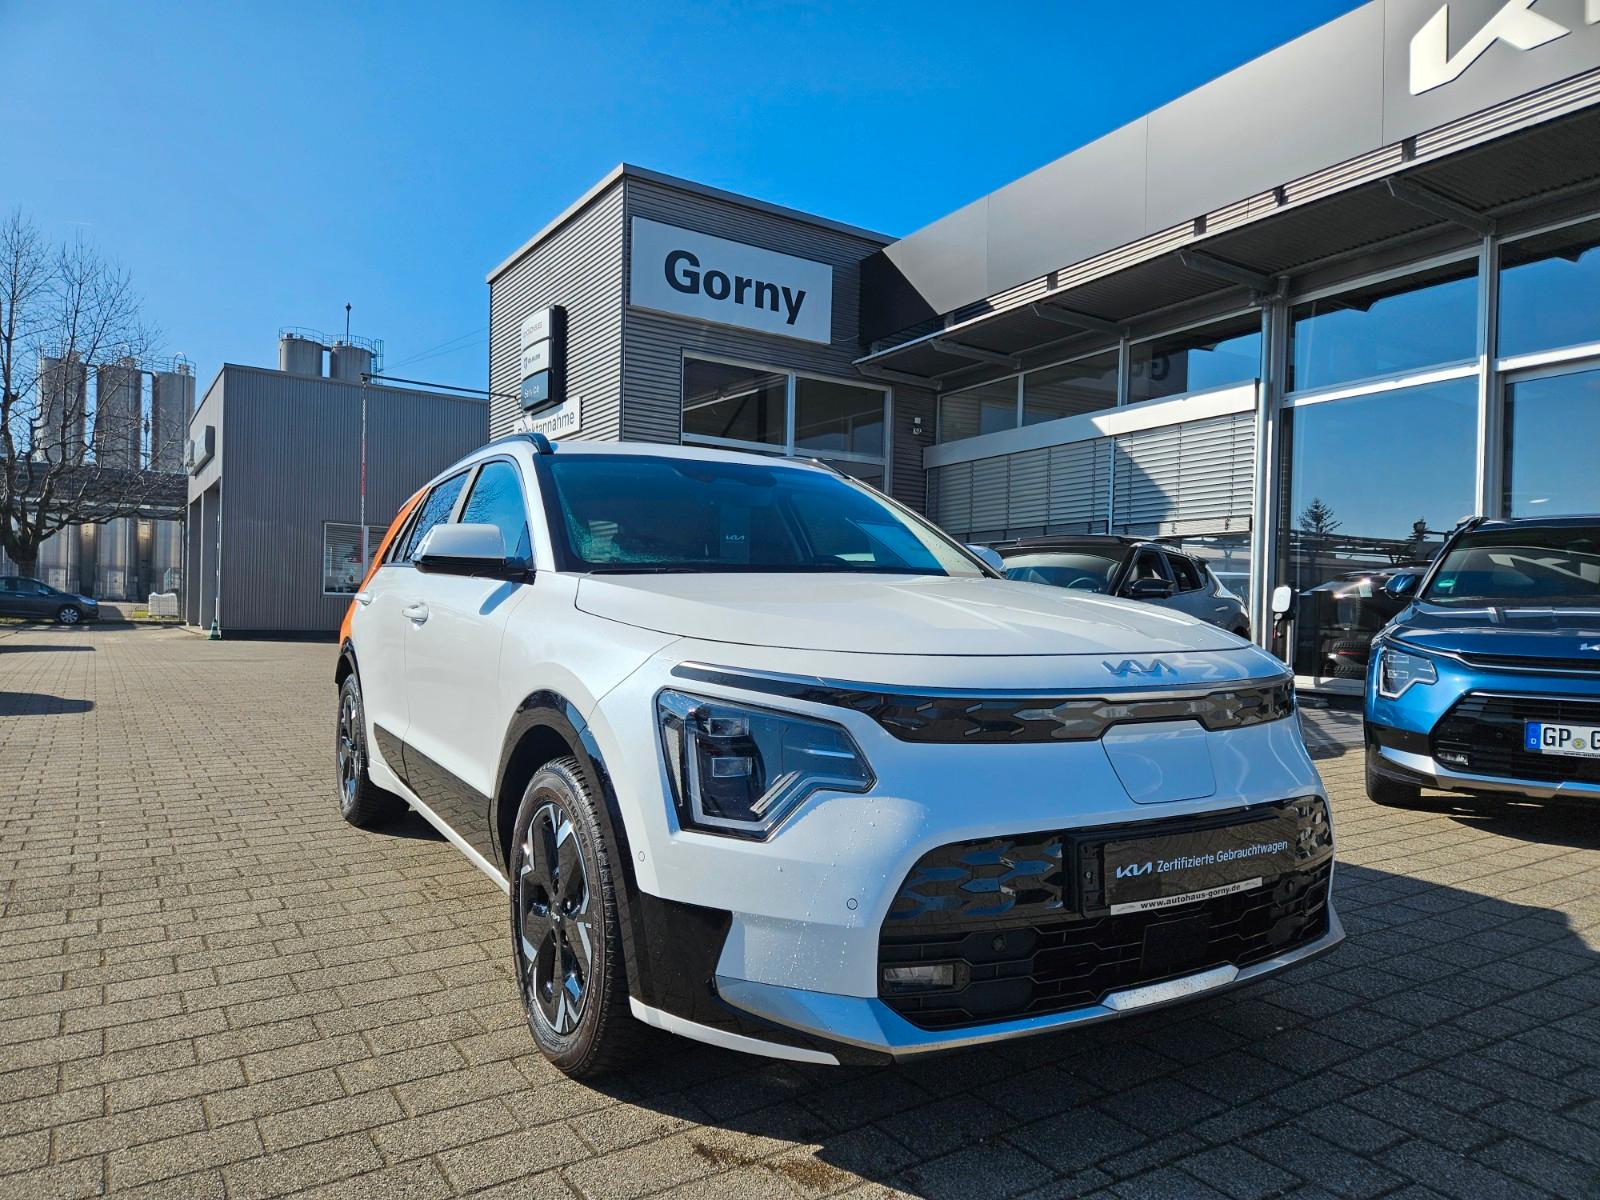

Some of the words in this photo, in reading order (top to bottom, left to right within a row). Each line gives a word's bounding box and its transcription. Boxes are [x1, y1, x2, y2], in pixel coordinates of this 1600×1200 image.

[664, 249, 806, 324] Gorny
[1543, 727, 1572, 748] GP
[1116, 862, 1152, 879] KIA
[1157, 854, 1214, 873] Zertifizierte
[1216, 840, 1288, 862] Gebrauchtwagen
[1140, 884, 1241, 910] www.autohaus-gorny.de
